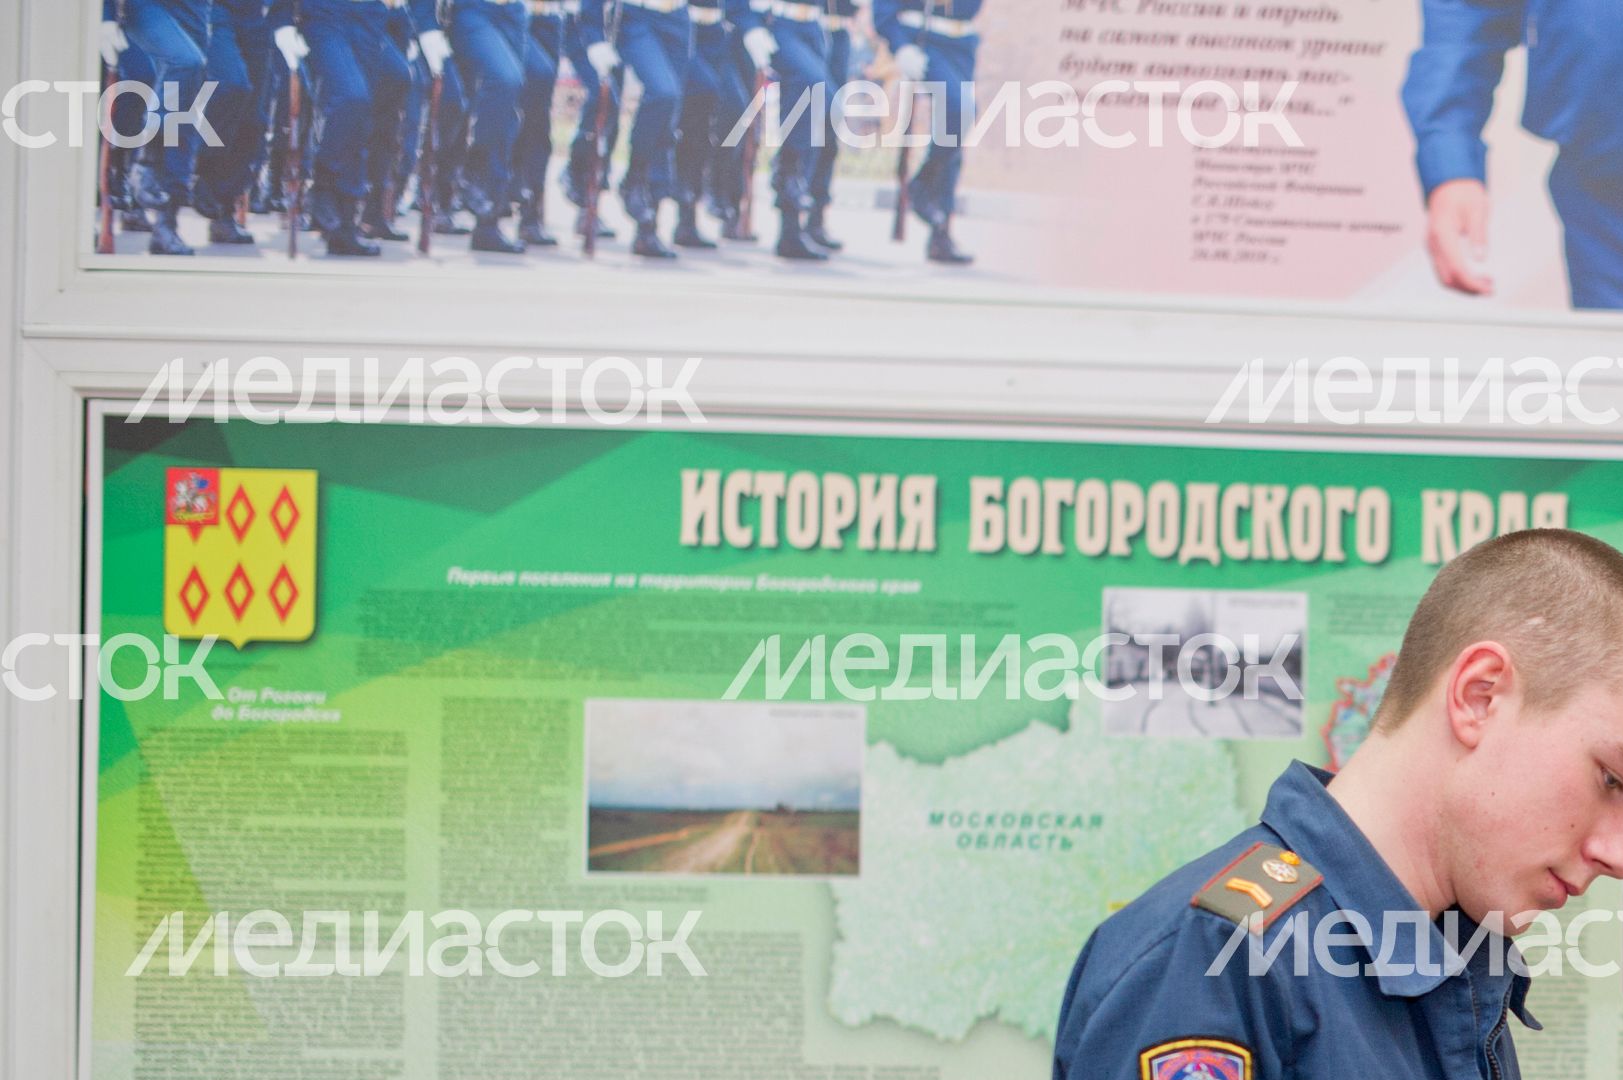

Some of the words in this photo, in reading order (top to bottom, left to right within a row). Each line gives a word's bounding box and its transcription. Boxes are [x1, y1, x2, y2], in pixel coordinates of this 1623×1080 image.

[680, 468, 938, 554] ИСТОРИЯ
[968, 476, 1392, 566] БОГОРОДСКОГО
[447, 566, 516, 588] Первые
[519, 570, 612, 590] поселения
[614, 572, 637, 589] на
[639, 572, 754, 592] территории
[927, 811, 1104, 829] МОСКОВСКАЯ
[956, 833, 1075, 852] ОБЛАСТЬ
